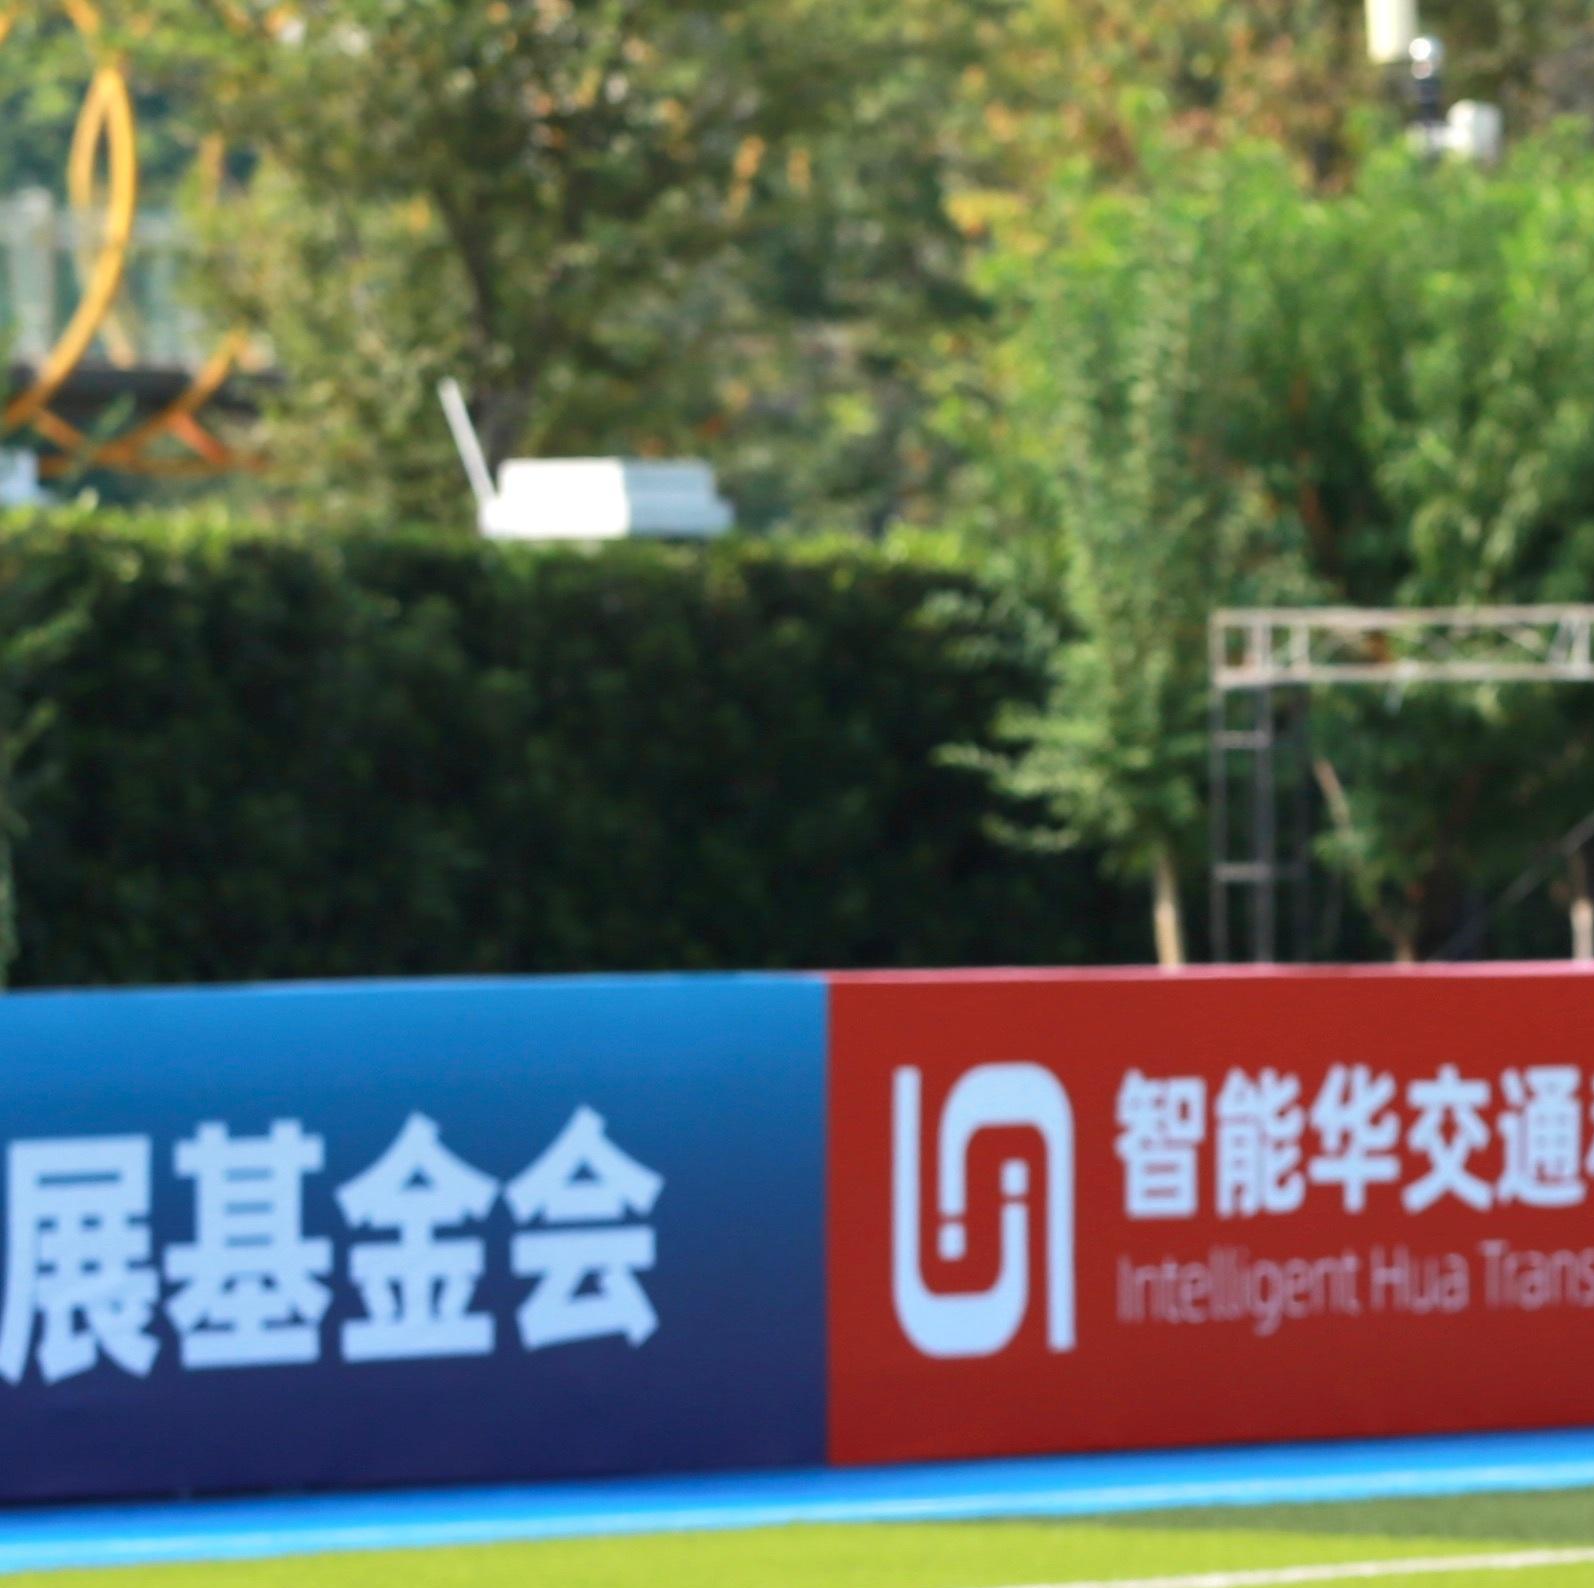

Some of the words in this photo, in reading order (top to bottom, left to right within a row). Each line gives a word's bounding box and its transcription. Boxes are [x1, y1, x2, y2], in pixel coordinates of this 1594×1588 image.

[0, 1105, 664, 1384] 展基金会
[1116, 1244, 1361, 1336] Intelligent
[1370, 1243, 1470, 1315] Hua
